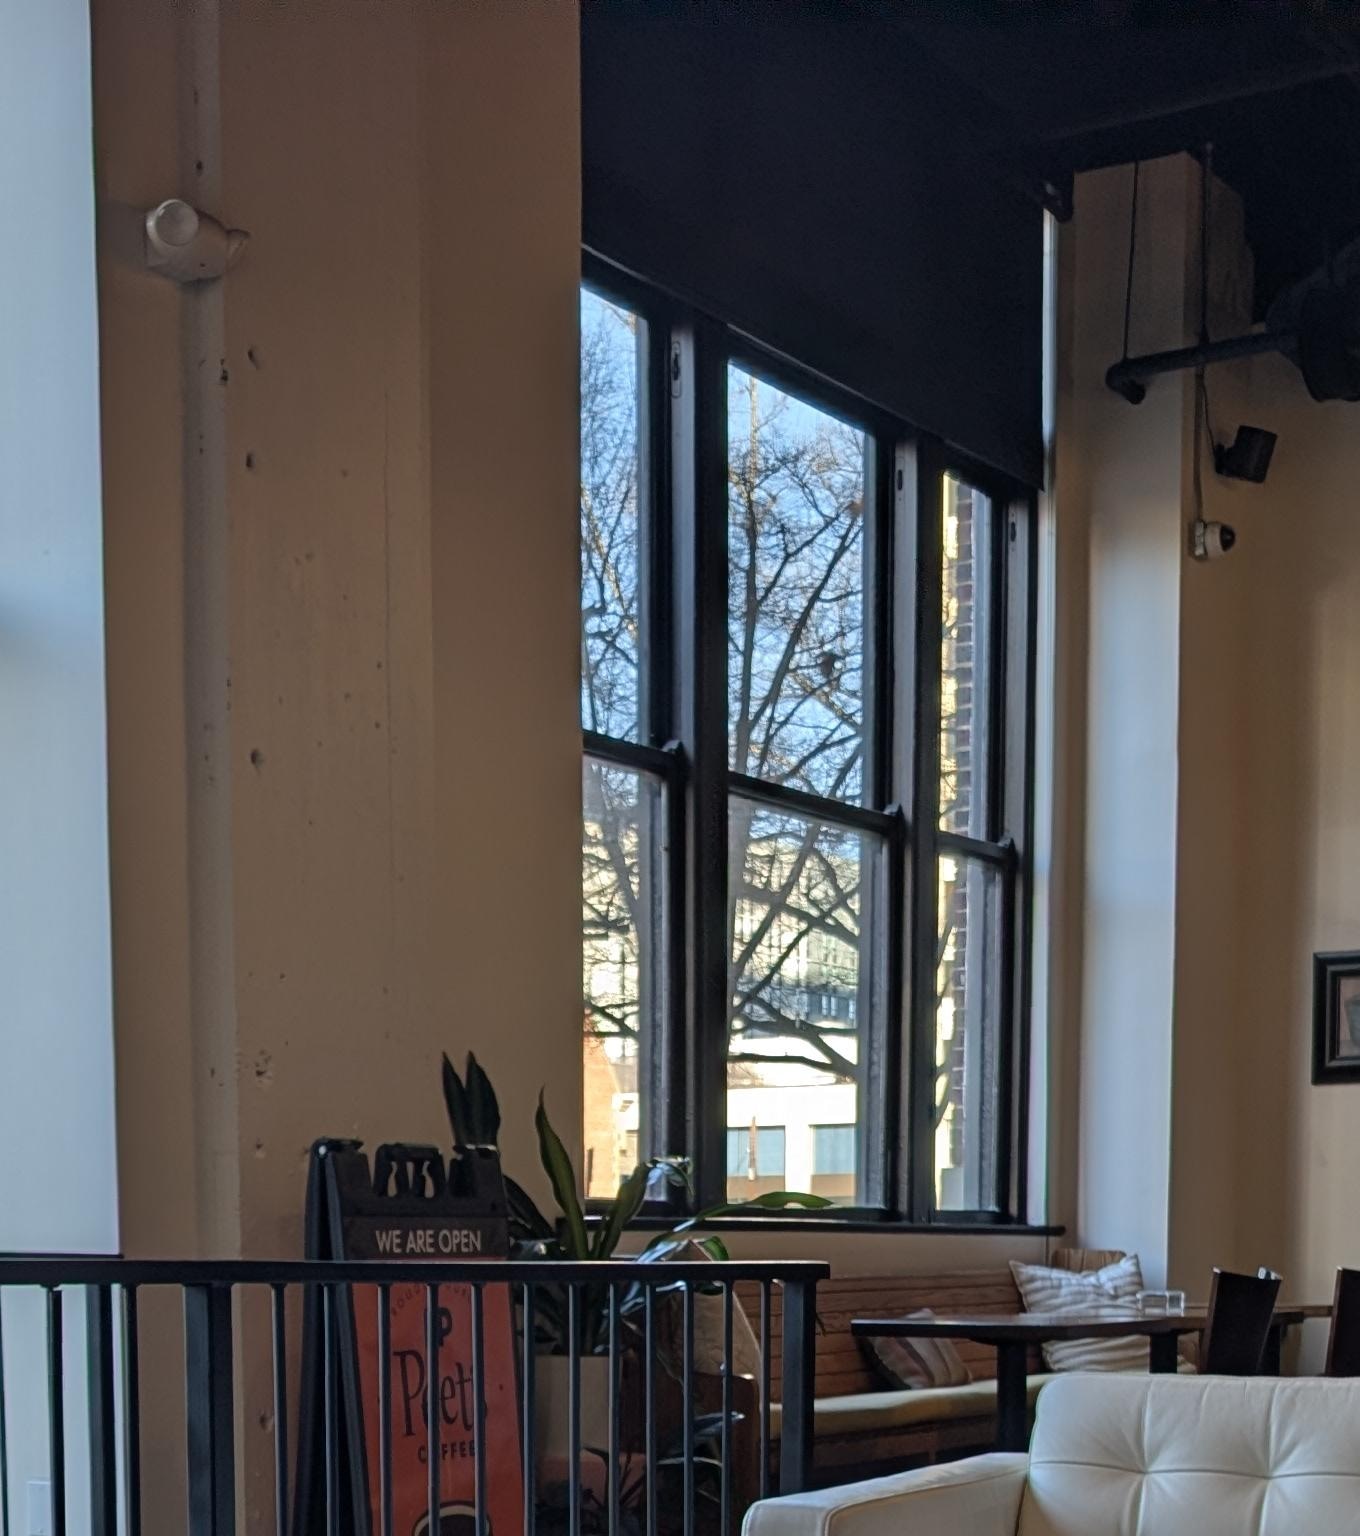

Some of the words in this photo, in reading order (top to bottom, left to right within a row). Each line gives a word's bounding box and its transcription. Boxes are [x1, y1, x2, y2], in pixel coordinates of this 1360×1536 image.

[376, 1229, 401, 1253] WE
[406, 1229, 436, 1253] ARE
[438, 1229, 482, 1253] OPEN
